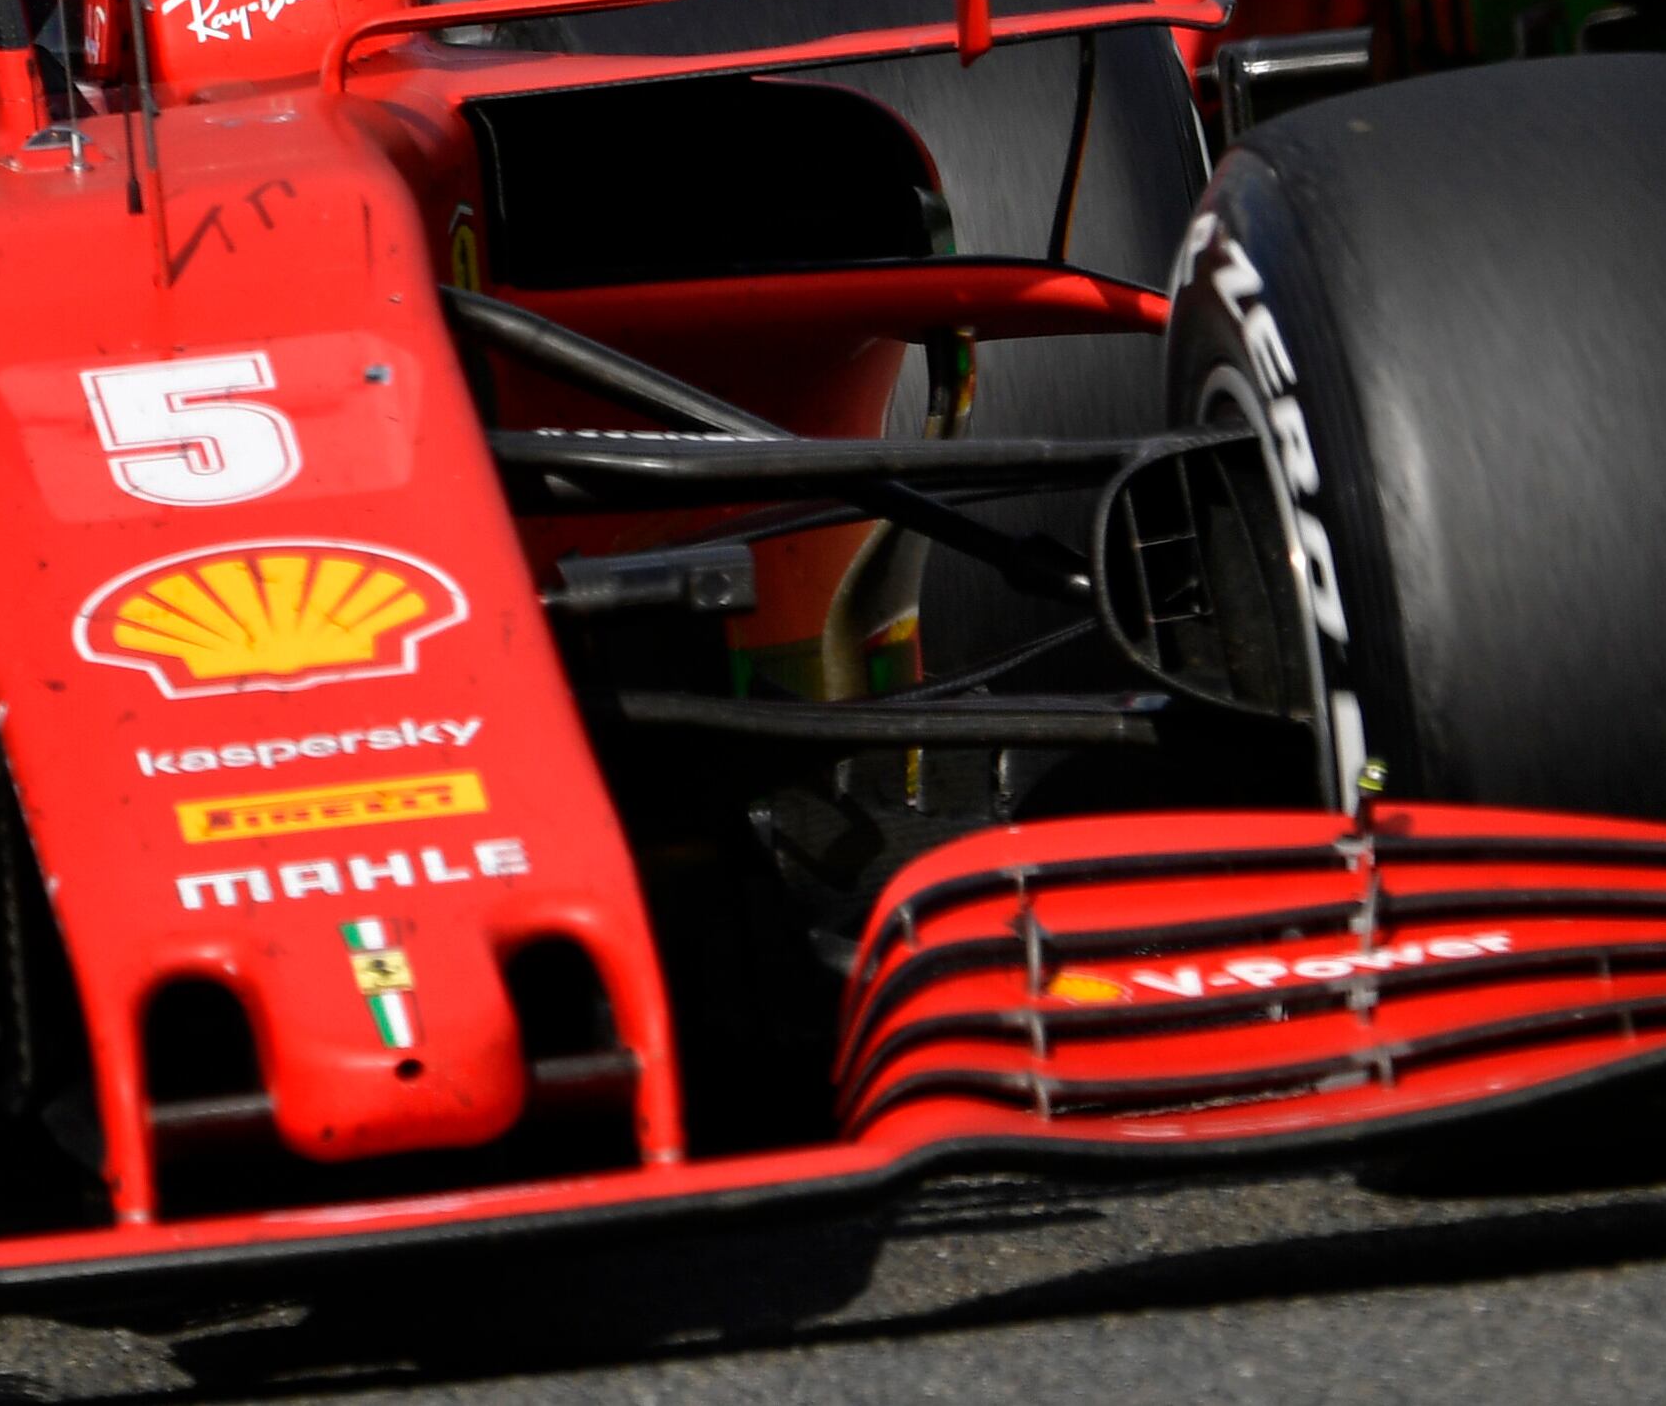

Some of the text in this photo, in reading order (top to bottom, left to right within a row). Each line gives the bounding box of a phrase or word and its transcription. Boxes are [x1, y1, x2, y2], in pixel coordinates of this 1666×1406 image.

[79, 350, 302, 507] 5
[135, 716, 484, 778] kaspersky
[176, 837, 531, 911] MAHLE
[1132, 930, 1514, 997] V-Power
